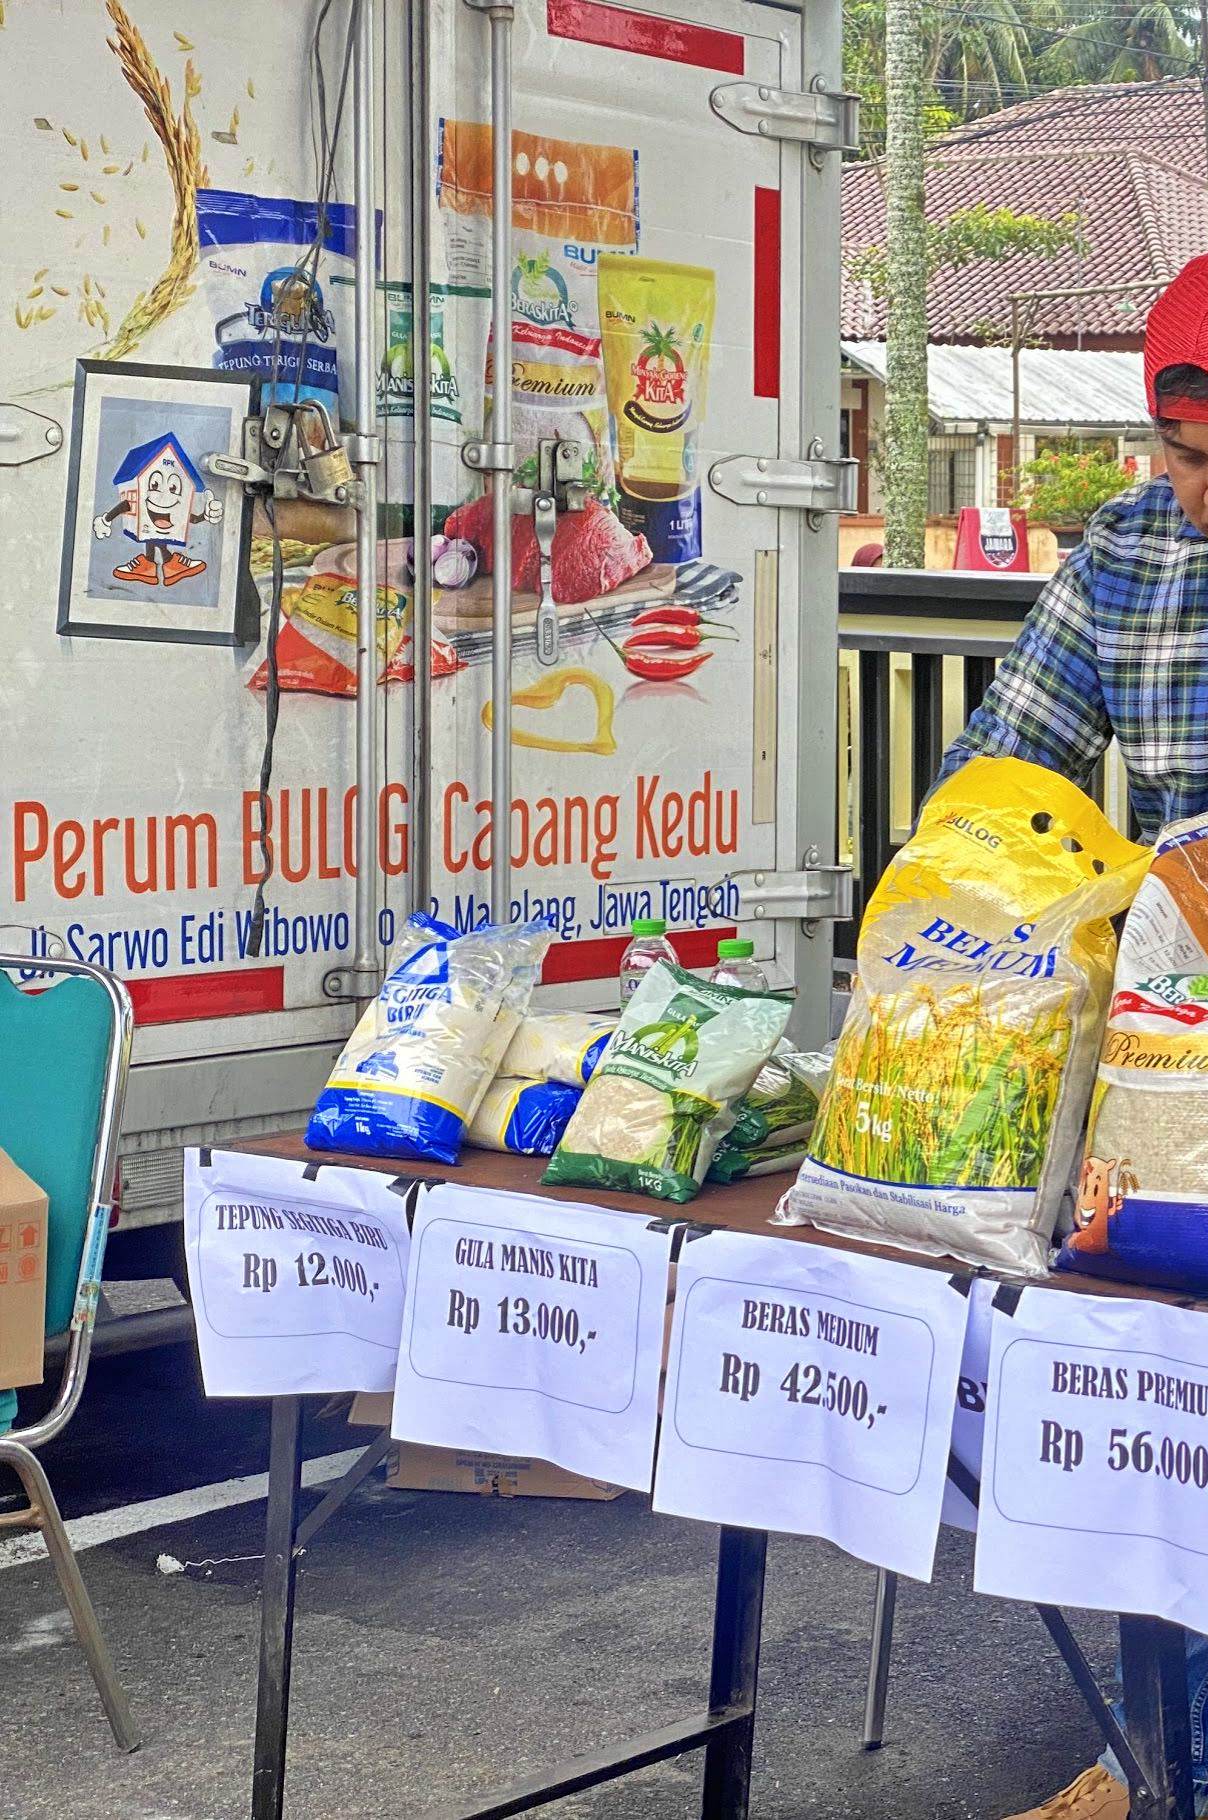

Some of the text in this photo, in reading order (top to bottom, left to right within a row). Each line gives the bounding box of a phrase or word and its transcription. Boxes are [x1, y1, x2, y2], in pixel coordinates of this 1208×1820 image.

[605, 310, 636, 323] BUMN
[306, 357, 337, 375] SERBA
[13, 800, 218, 902] Perum
[636, 770, 739, 860] Kedu
[66, 921, 169, 977] Sarwo
[181, 906, 224, 965] Edi
[235, 905, 349, 961] Wibowo
[455, 888, 581, 941] Maelang,
[590, 884, 651, 931] Jawa
[660, 874, 740, 928] Tengah
[379, 983, 452, 1005] EGITIGA
[638, 1176, 662, 1192] 1KG
[839, 1178, 872, 1198] Pasokan
[873, 1186, 889, 1202] dan
[890, 1190, 932, 1211] Stabilisasi
[933, 1200, 967, 1217] Harga
[215, 1204, 388, 1251] TEPUNG SEGITIGA BIRU
[242, 1251, 380, 1303] Rp 12.000,-
[455, 1236, 599, 1288] GULA MANIS KITA
[447, 1288, 597, 1355] Rp 13.000,-
[741, 1299, 880, 1356] BERAS MEDIUM
[719, 1352, 887, 1430] Rp 42.500,-
[1051, 1360, 1129, 1400] BERAS
[1039, 1419, 1084, 1473] Rp
